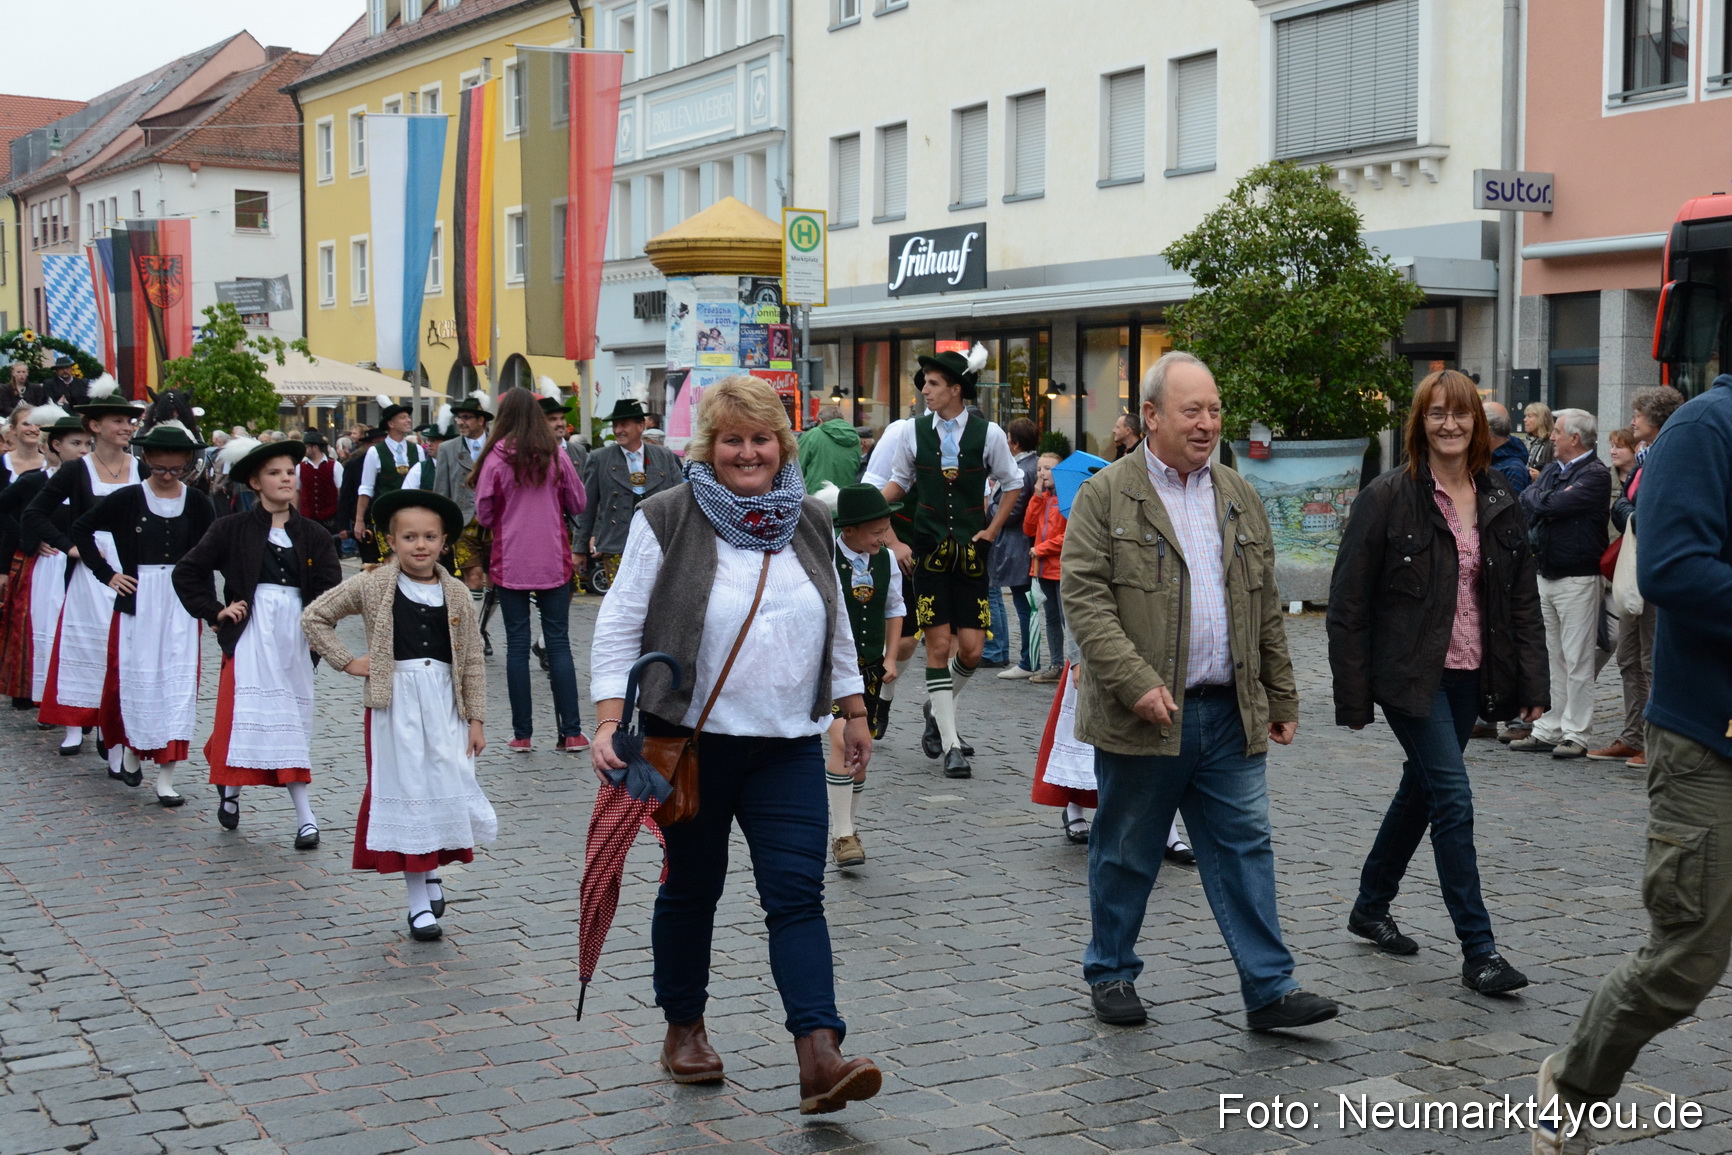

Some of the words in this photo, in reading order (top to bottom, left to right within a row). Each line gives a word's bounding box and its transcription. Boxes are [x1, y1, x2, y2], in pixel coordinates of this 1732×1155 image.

[652, 103, 692, 135] BRILLEN
[694, 92, 733, 125] WEBER
[790, 255, 819, 263] Marktplatz
[888, 231, 979, 291] frühauf
